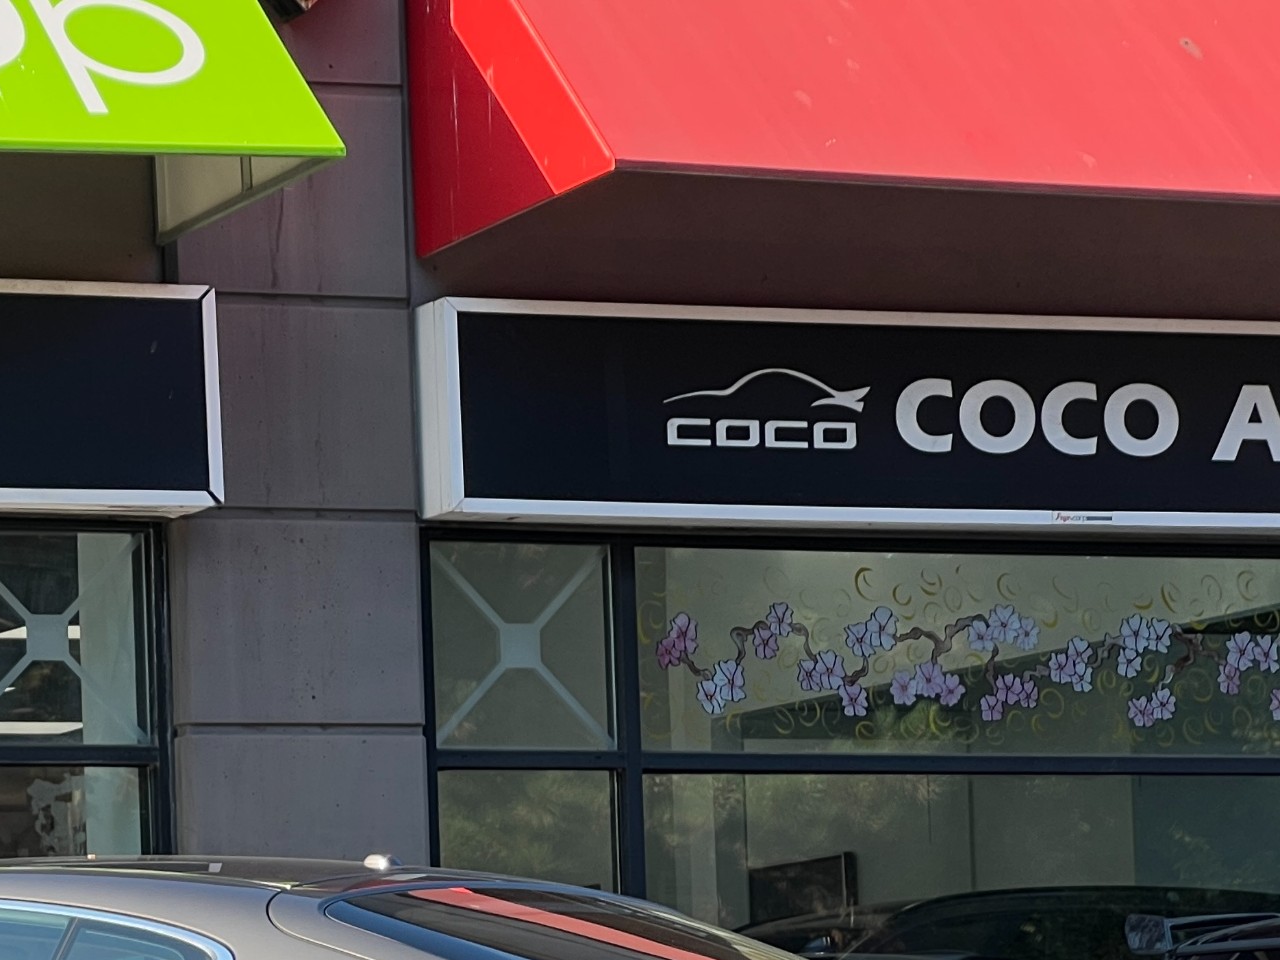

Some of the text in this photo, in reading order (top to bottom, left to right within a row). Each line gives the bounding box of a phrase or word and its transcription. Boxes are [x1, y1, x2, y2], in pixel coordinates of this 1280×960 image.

[666, 417, 858, 450] COCO
[895, 378, 1280, 462] COCO A
